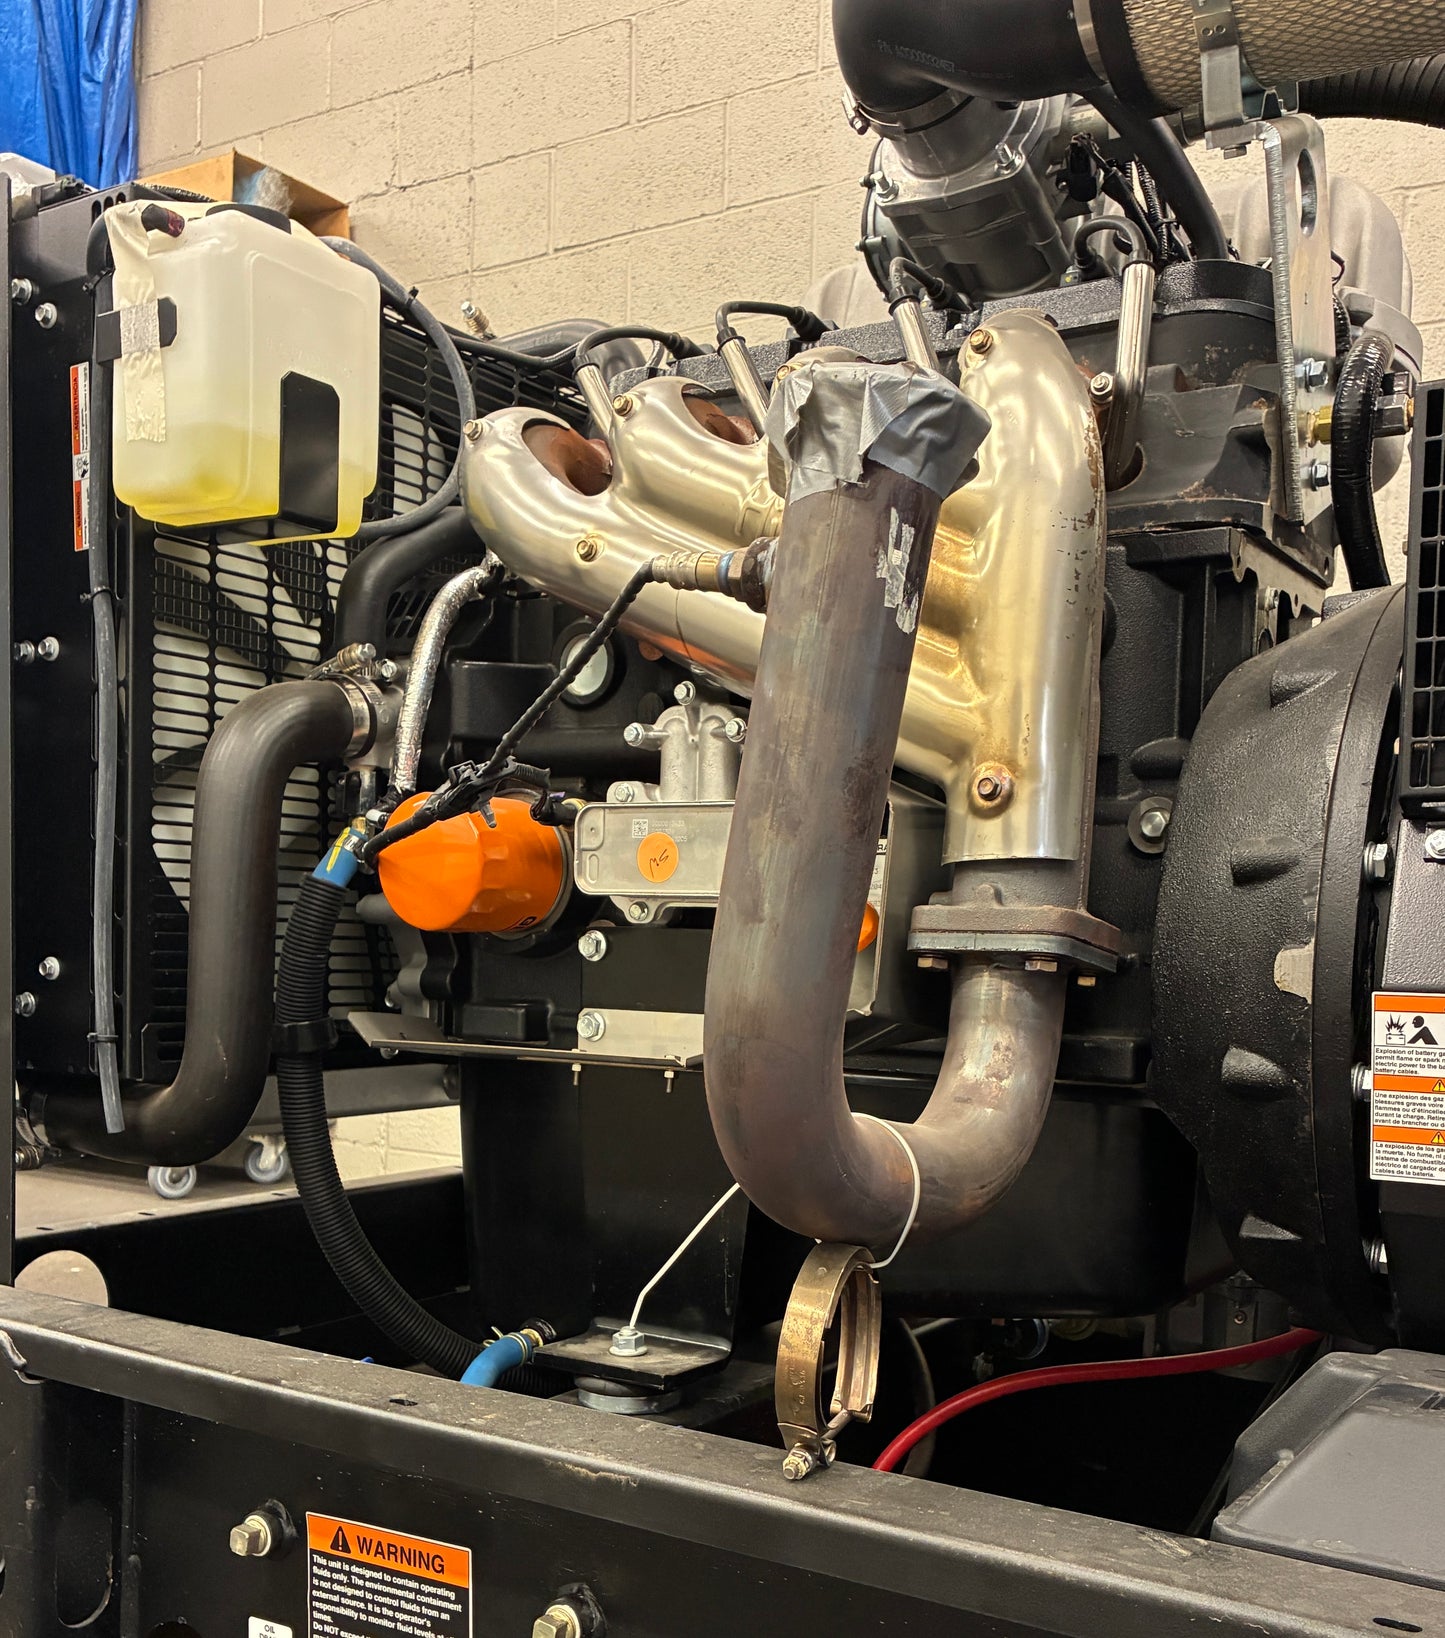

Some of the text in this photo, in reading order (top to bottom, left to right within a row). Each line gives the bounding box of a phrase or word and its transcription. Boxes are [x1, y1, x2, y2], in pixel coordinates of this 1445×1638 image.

[356, 1535, 445, 1575] WARNING
[312, 1554, 456, 1600] This unit is designed to contain operating
[312, 1565, 462, 1612] fluids only. The environmental containment
[312, 1577, 450, 1621] is not designed to control fluids from an
[312, 1589, 431, 1627] external source. It is the operator's
[312, 1610, 333, 1623] times.
[264, 1624, 275, 1634] OIL
[312, 1601, 358, 1620] responsibility
[359, 1612, 367, 1621] to
[368, 1616, 396, 1629] monitor
[396, 1622, 413, 1634] fluid
[413, 1627, 435, 1638] levels
[312, 1621, 323, 1631] Do
[323, 1624, 340, 1635] NOT
